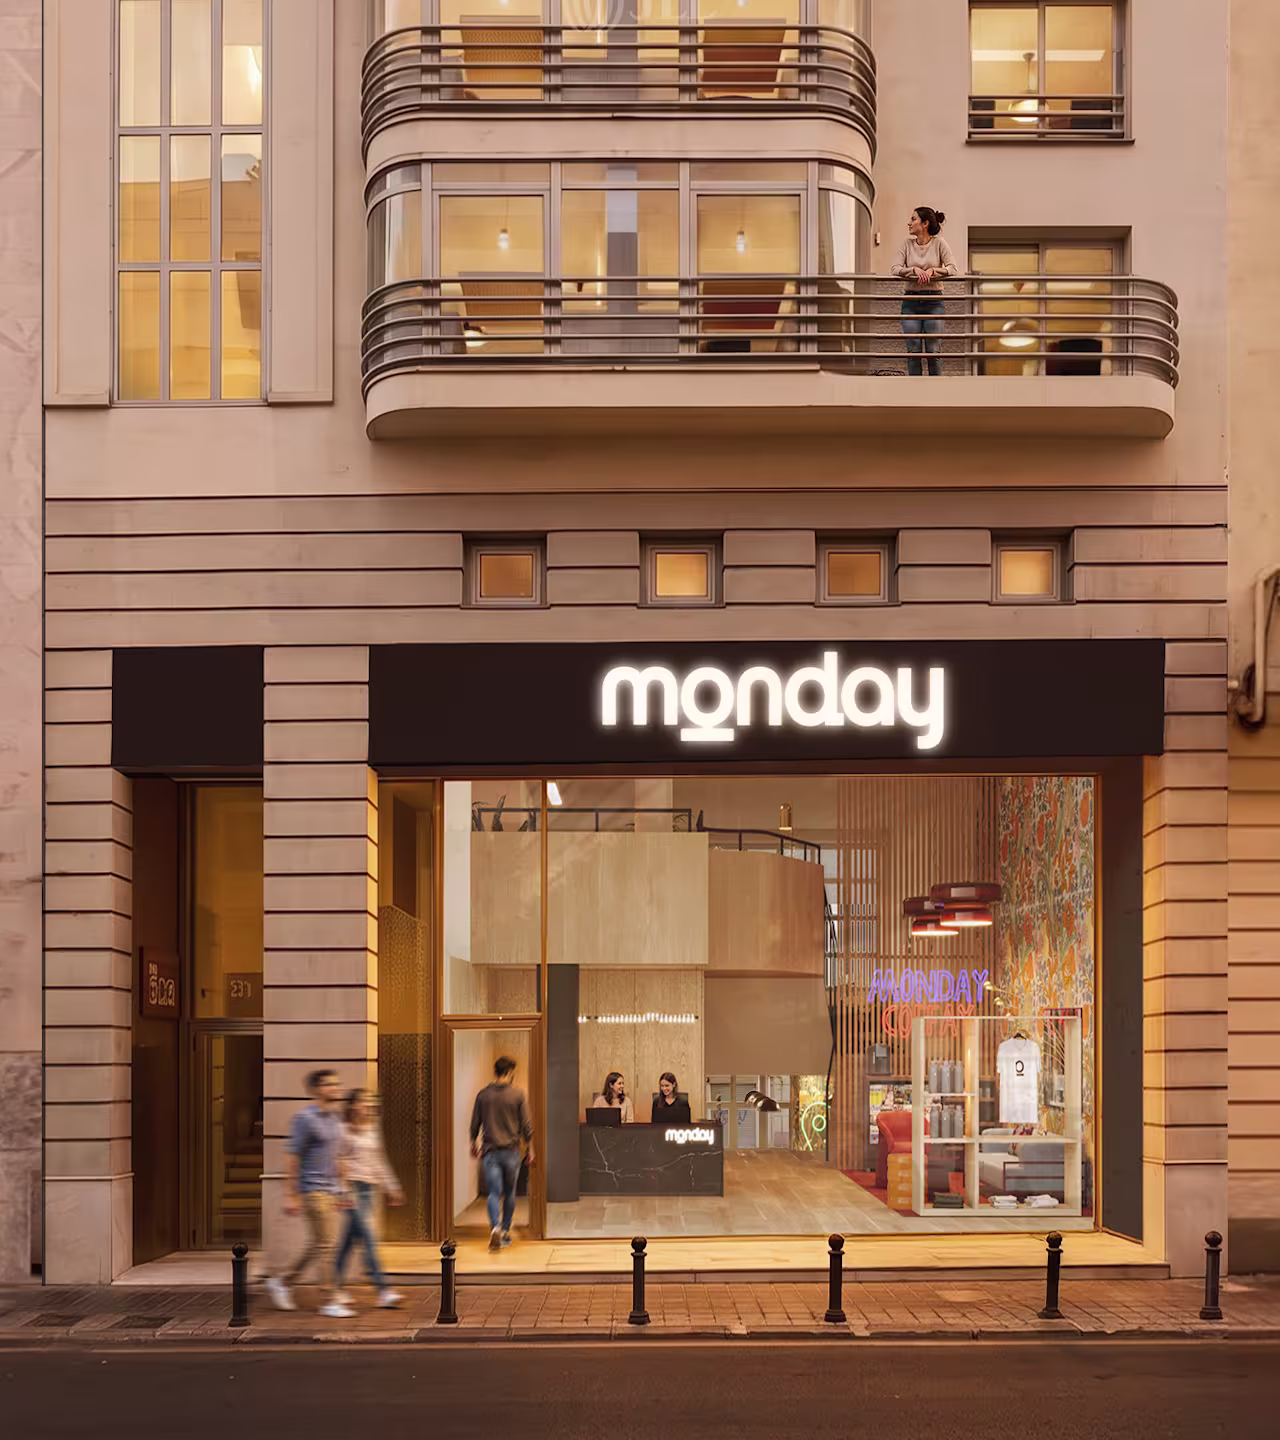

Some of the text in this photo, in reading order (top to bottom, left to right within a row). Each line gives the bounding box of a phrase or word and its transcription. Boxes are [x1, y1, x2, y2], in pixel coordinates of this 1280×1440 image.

[602, 651, 945, 749] monday
[867, 968, 989, 1003] MONDAY
[664, 1126, 715, 1146] monday
